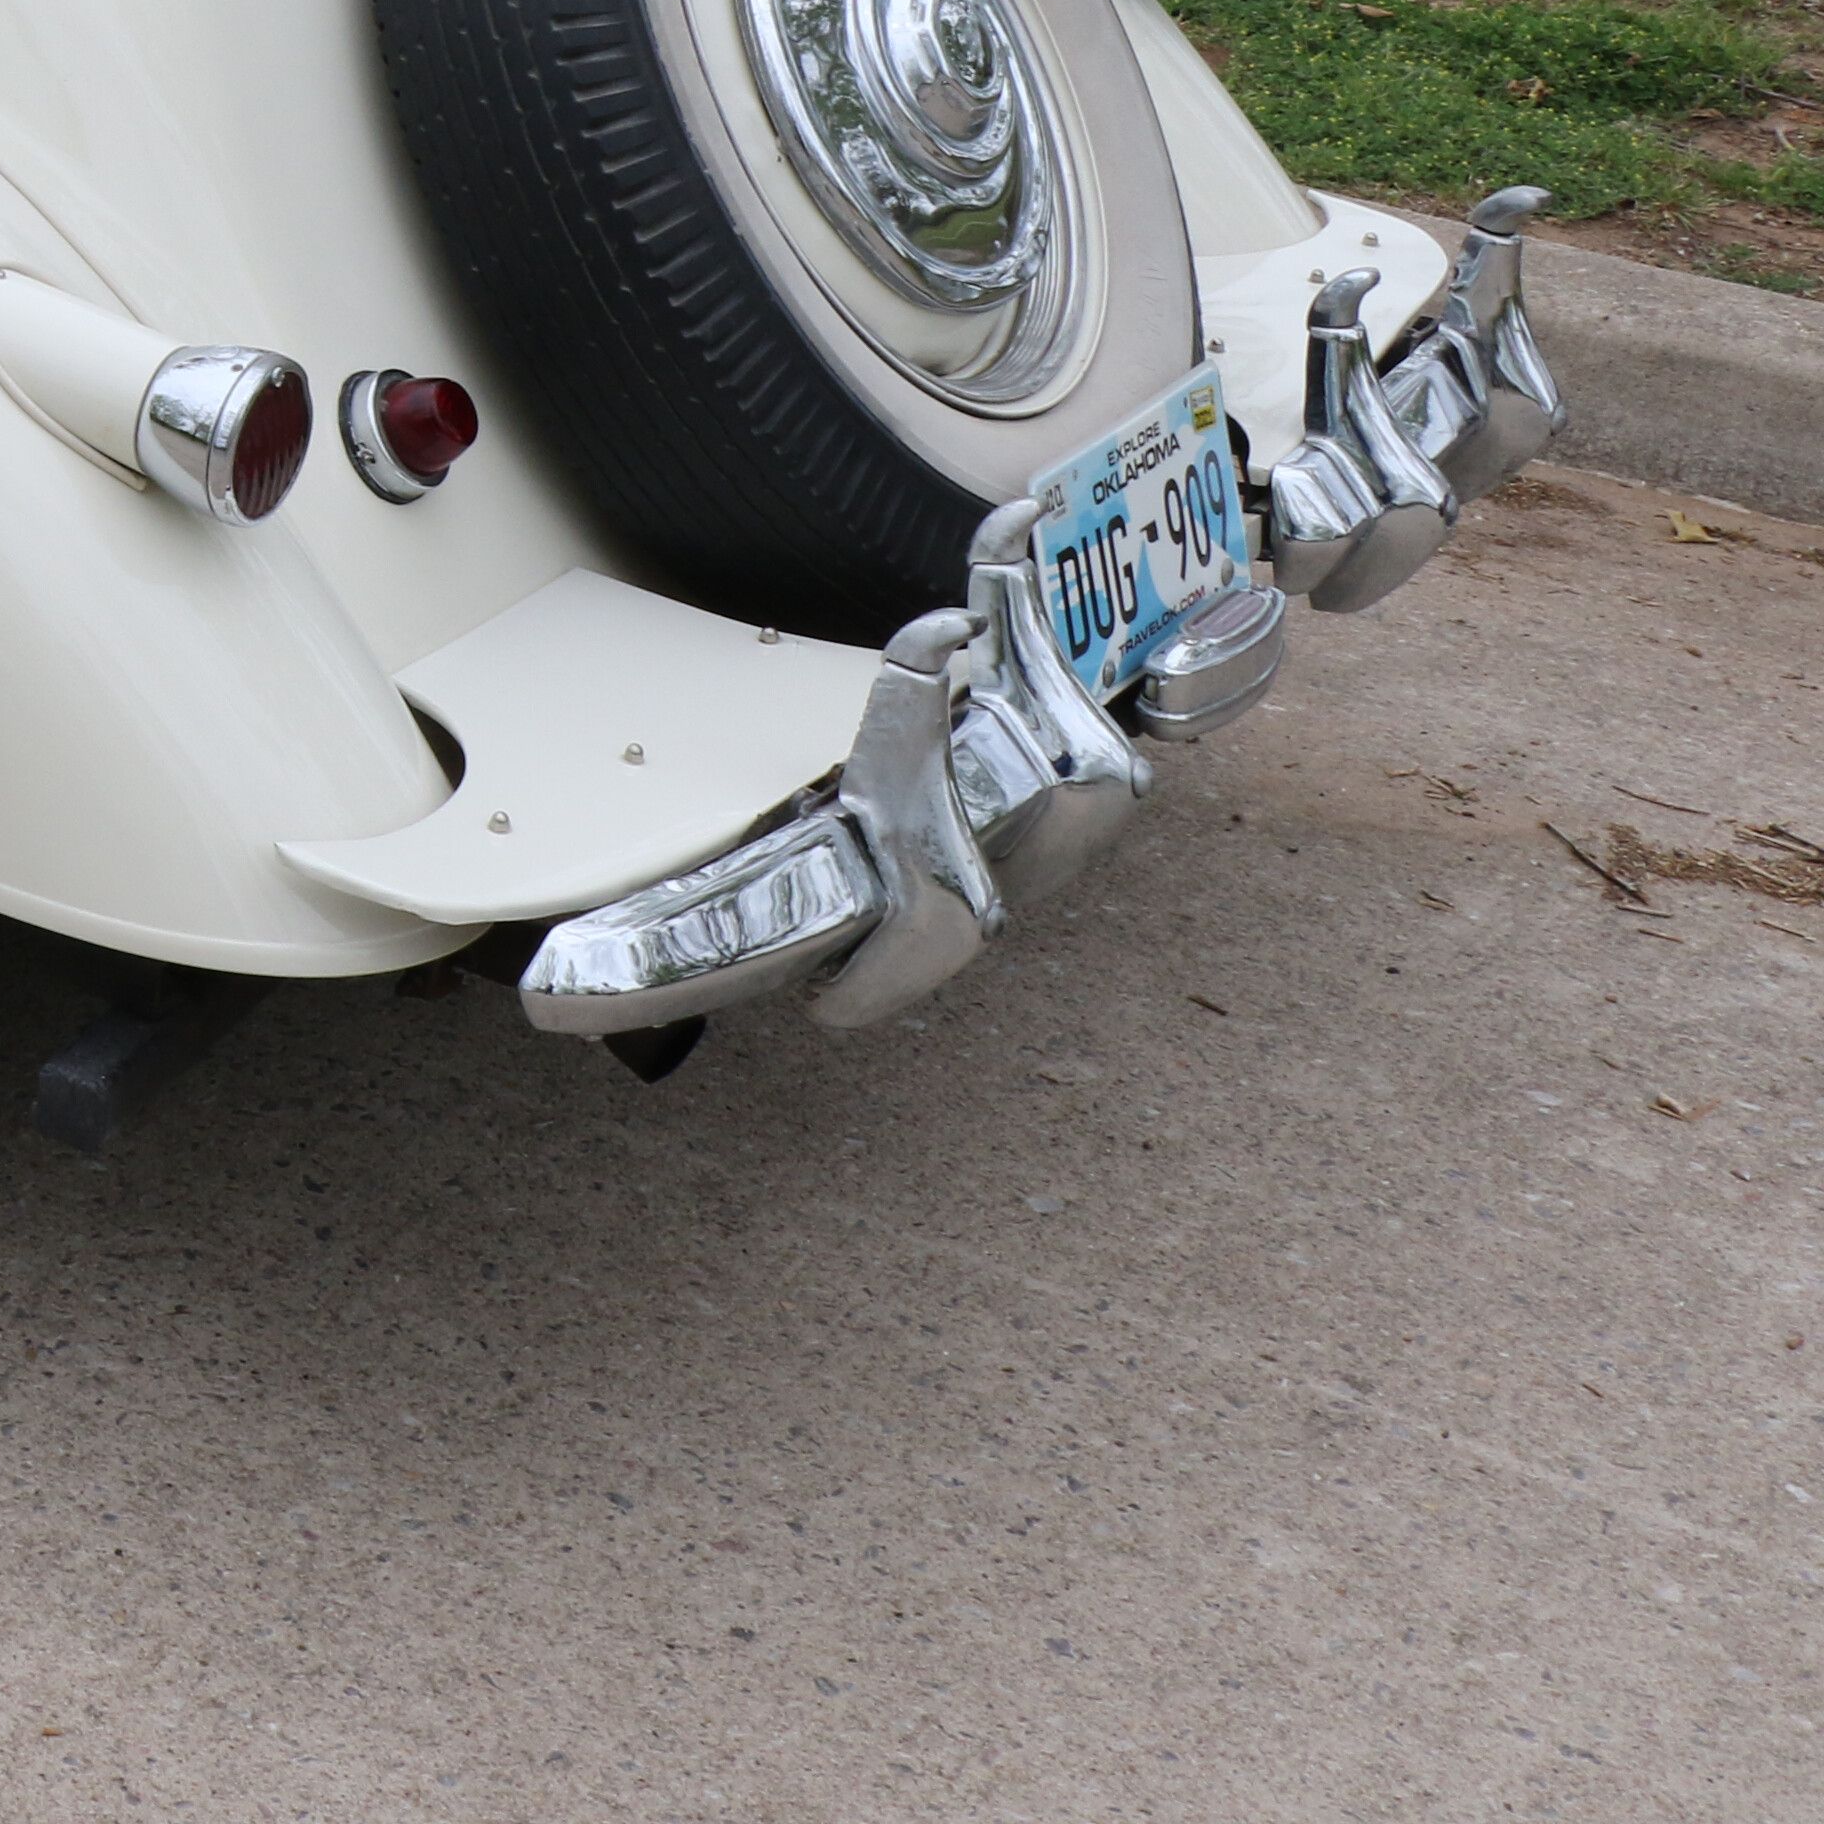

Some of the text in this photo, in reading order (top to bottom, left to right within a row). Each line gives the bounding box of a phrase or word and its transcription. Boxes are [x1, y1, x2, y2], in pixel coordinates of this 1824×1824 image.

[1093, 432, 1181, 505] OKLAHOMA
[1107, 421, 1161, 466] EXPLORE
[1118, 585, 1206, 657] TRAVELOK.COM
